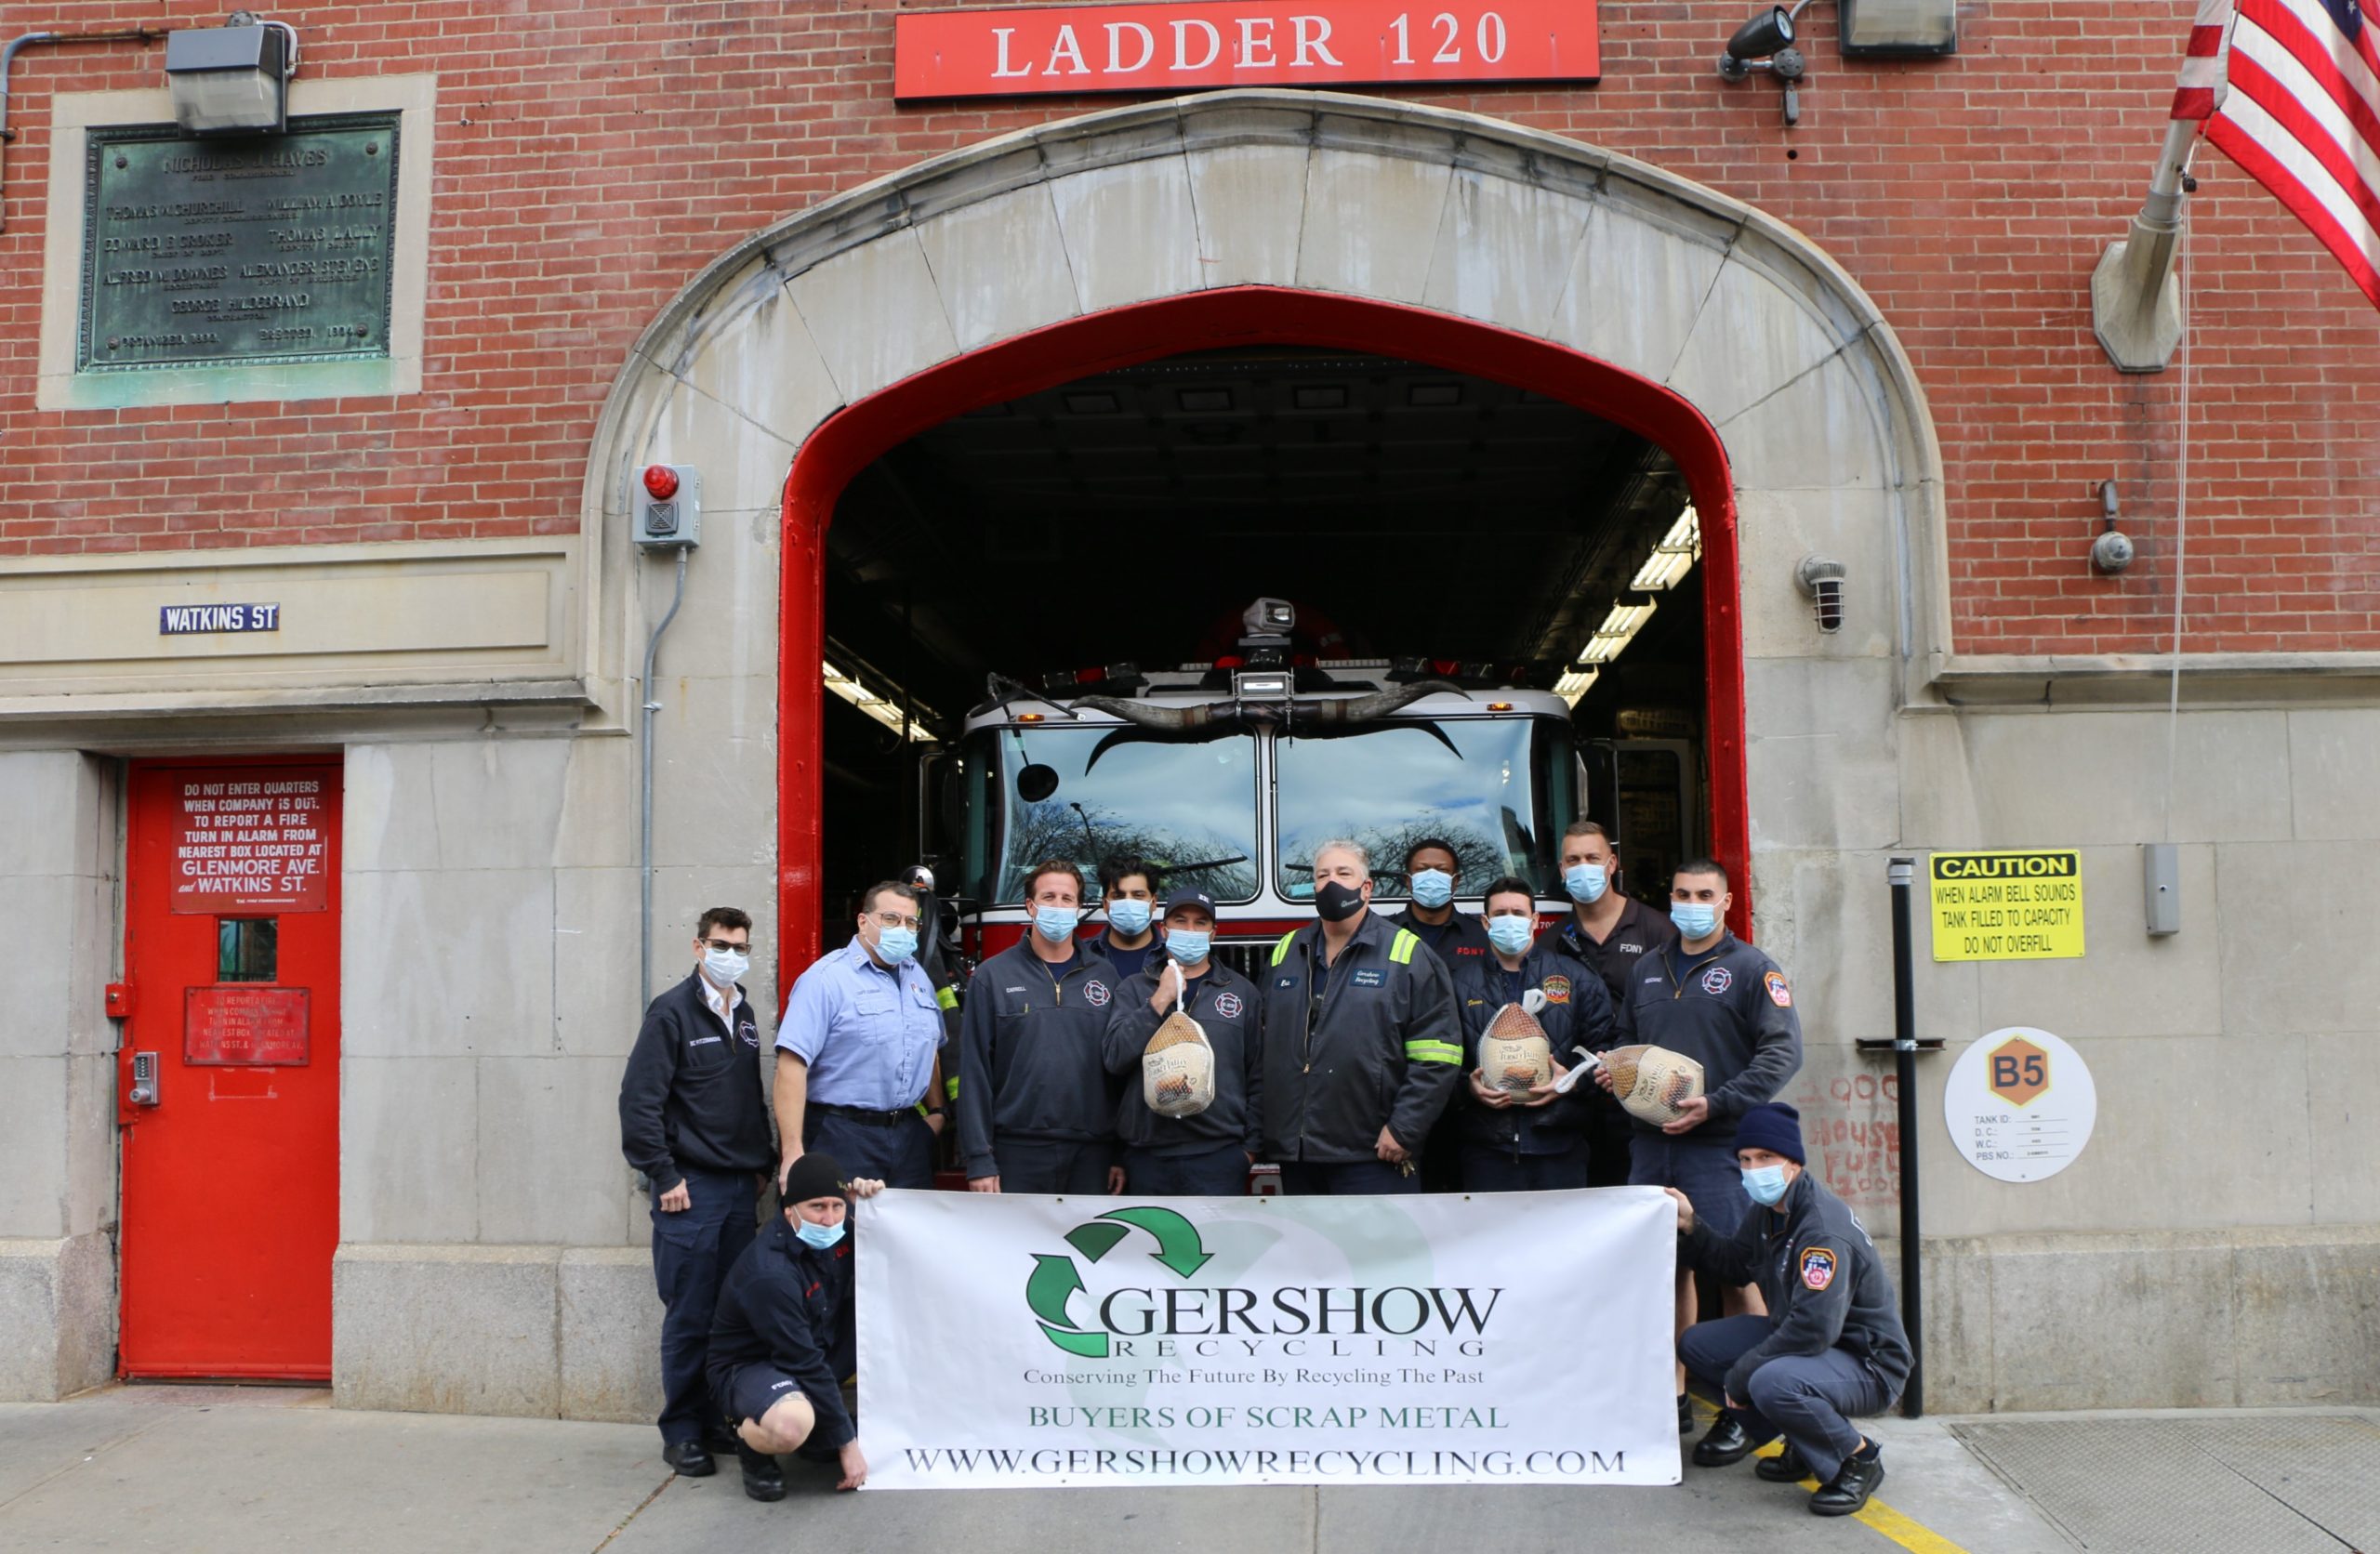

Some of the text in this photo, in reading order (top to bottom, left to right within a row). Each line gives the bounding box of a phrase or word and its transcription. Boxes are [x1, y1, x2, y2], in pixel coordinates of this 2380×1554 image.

[990, 12, 1507, 78] LADDER 120
[106, 205, 157, 222] THOMAS
[103, 235, 161, 255] EDWARD
[179, 231, 234, 251] CROKER
[269, 228, 325, 245] THOMAS
[103, 269, 153, 286] ALFRED
[172, 264, 229, 283] DOWNES
[239, 260, 317, 279] ALEXANDER
[171, 298, 221, 314] GEORGE
[166, 605, 277, 631] WATKINS ST
[185, 781, 319, 797] DO NOT ENTER QUARTERS
[184, 797, 320, 812] WHEN COMPANY IS OUT.
[194, 813, 308, 827] TO REPORT A FIRE
[185, 828, 316, 843] TURN IN ALARM FROM
[178, 844, 323, 858] NEAREST BOX LOCATED AT
[182, 858, 320, 876] GLENMORE AVE.
[1940, 857, 2069, 877] CAUTION
[198, 876, 271, 893] WATKINS
[280, 876, 307, 892] ST.
[1935, 884, 2076, 904] WHEN ALARM BELL SOUNDS
[1942, 908, 2070, 928] TANK FILLED TO CAPACITY
[1457, 947, 1486, 956] FDNY
[1620, 943, 1644, 954] FDNY
[1964, 934, 2053, 954] DO NOT OVERFILL
[226, 995, 254, 1005] REPORT
[203, 1028, 235, 1037] NEAEST
[199, 1040, 231, 1049] WATNS
[1993, 1055, 2044, 1087] B5
[1974, 1115, 2012, 1125] TANK ID:
[1976, 1152, 1994, 1161] PBS
[1099, 1286, 1507, 1337] GERSHOW
[1113, 1339, 1485, 1358] RECYCLING
[1023, 1367, 1485, 1388] Conserving The Future By Recycling The Past
[1027, 1406, 1510, 1429] BUYERS OF SCRAP METAL
[905, 1448, 1627, 1476] WWW.GERSHOWRECYCLING.COM
